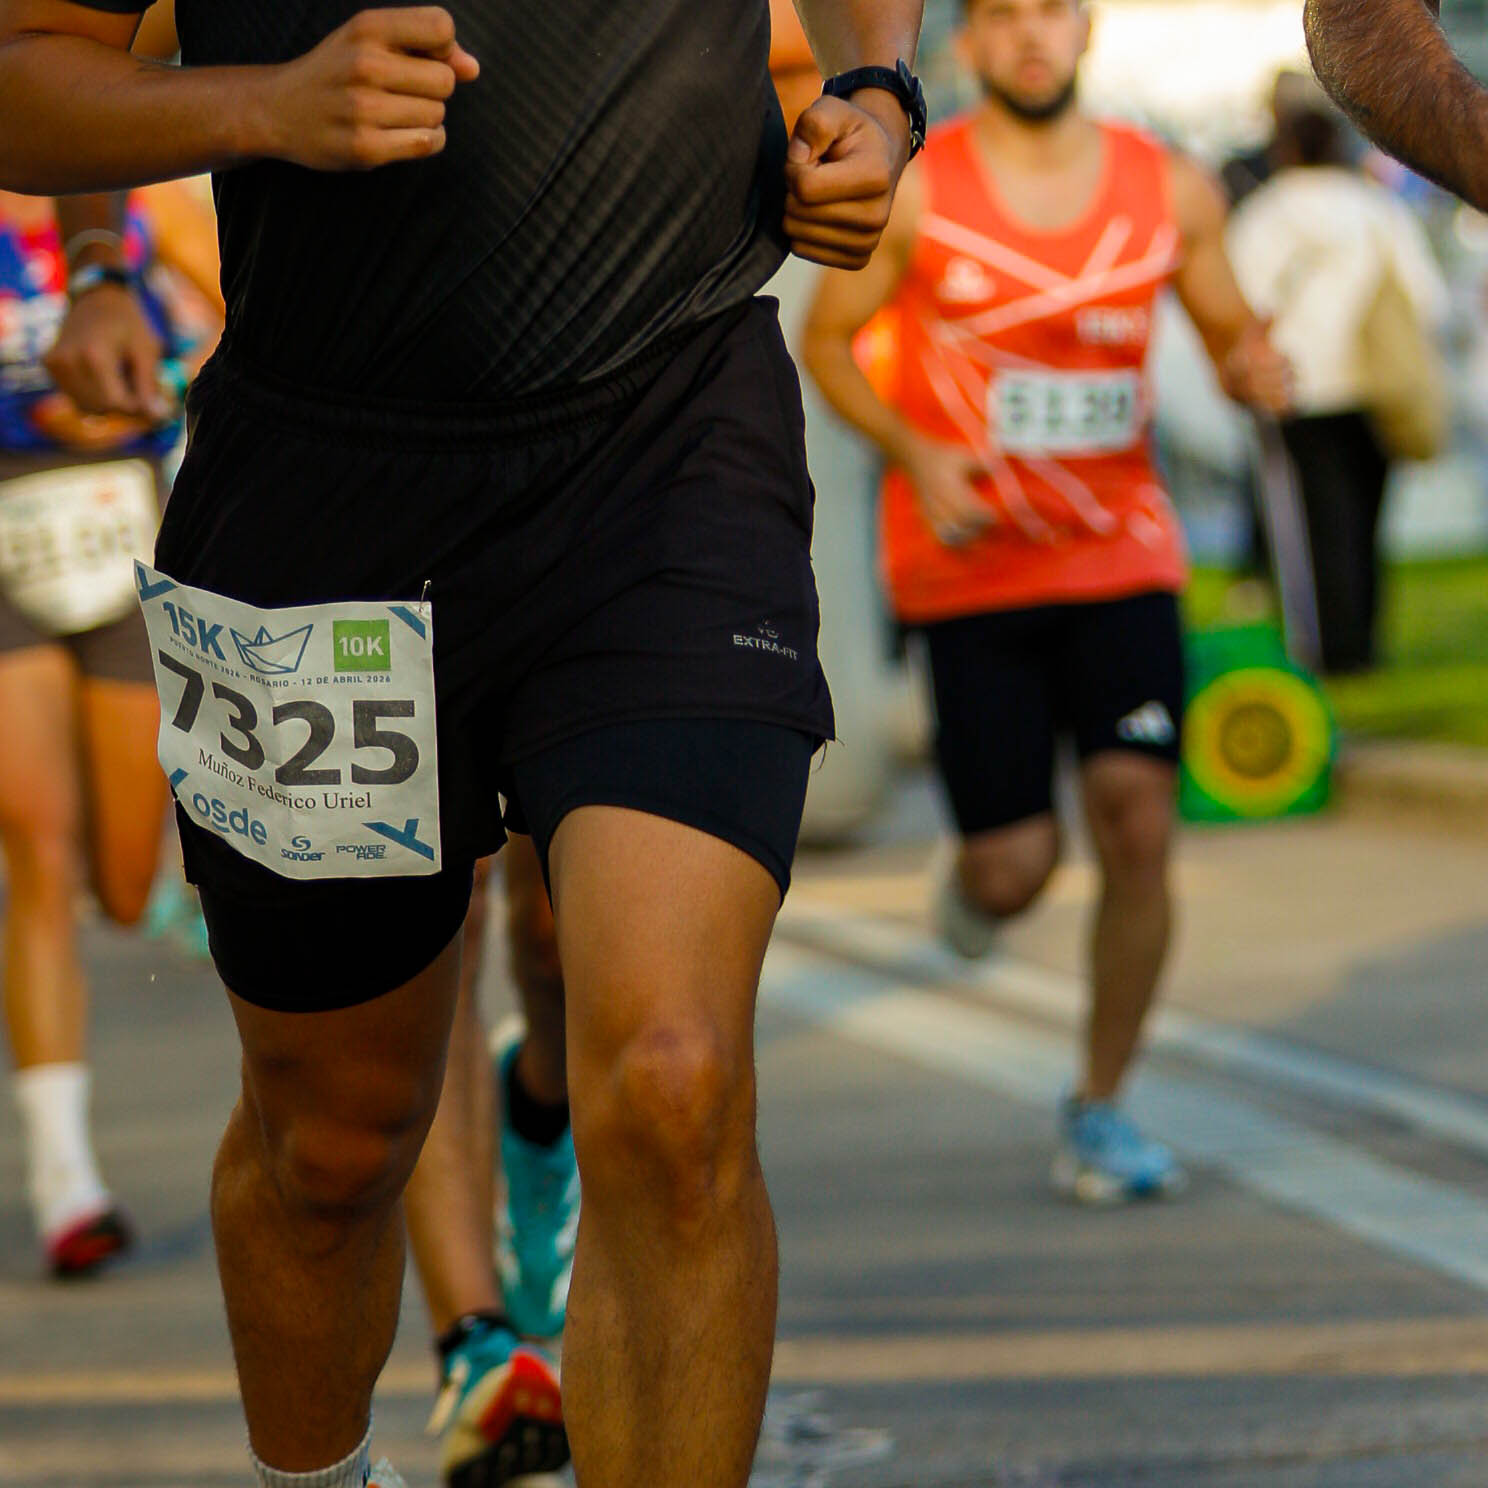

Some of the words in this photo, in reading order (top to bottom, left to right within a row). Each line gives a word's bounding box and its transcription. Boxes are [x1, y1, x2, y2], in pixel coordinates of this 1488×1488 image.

[162, 600, 227, 661] 15K
[338, 635, 385, 657] 10K
[732, 634, 798, 660] EXTRA-FIT
[250, 674, 289, 688] ROSARIO
[302, 677, 312, 687] 12
[316, 676, 329, 685] DE
[333, 675, 363, 684] ABRIL
[367, 675, 391, 684] 2026
[157, 648, 420, 786] 7325
[198, 748, 245, 788] Muñoz
[247, 775, 316, 809] Federico
[323, 792, 372, 809] Uriel
[192, 792, 268, 845] osde
[336, 844, 386, 853] POWER
